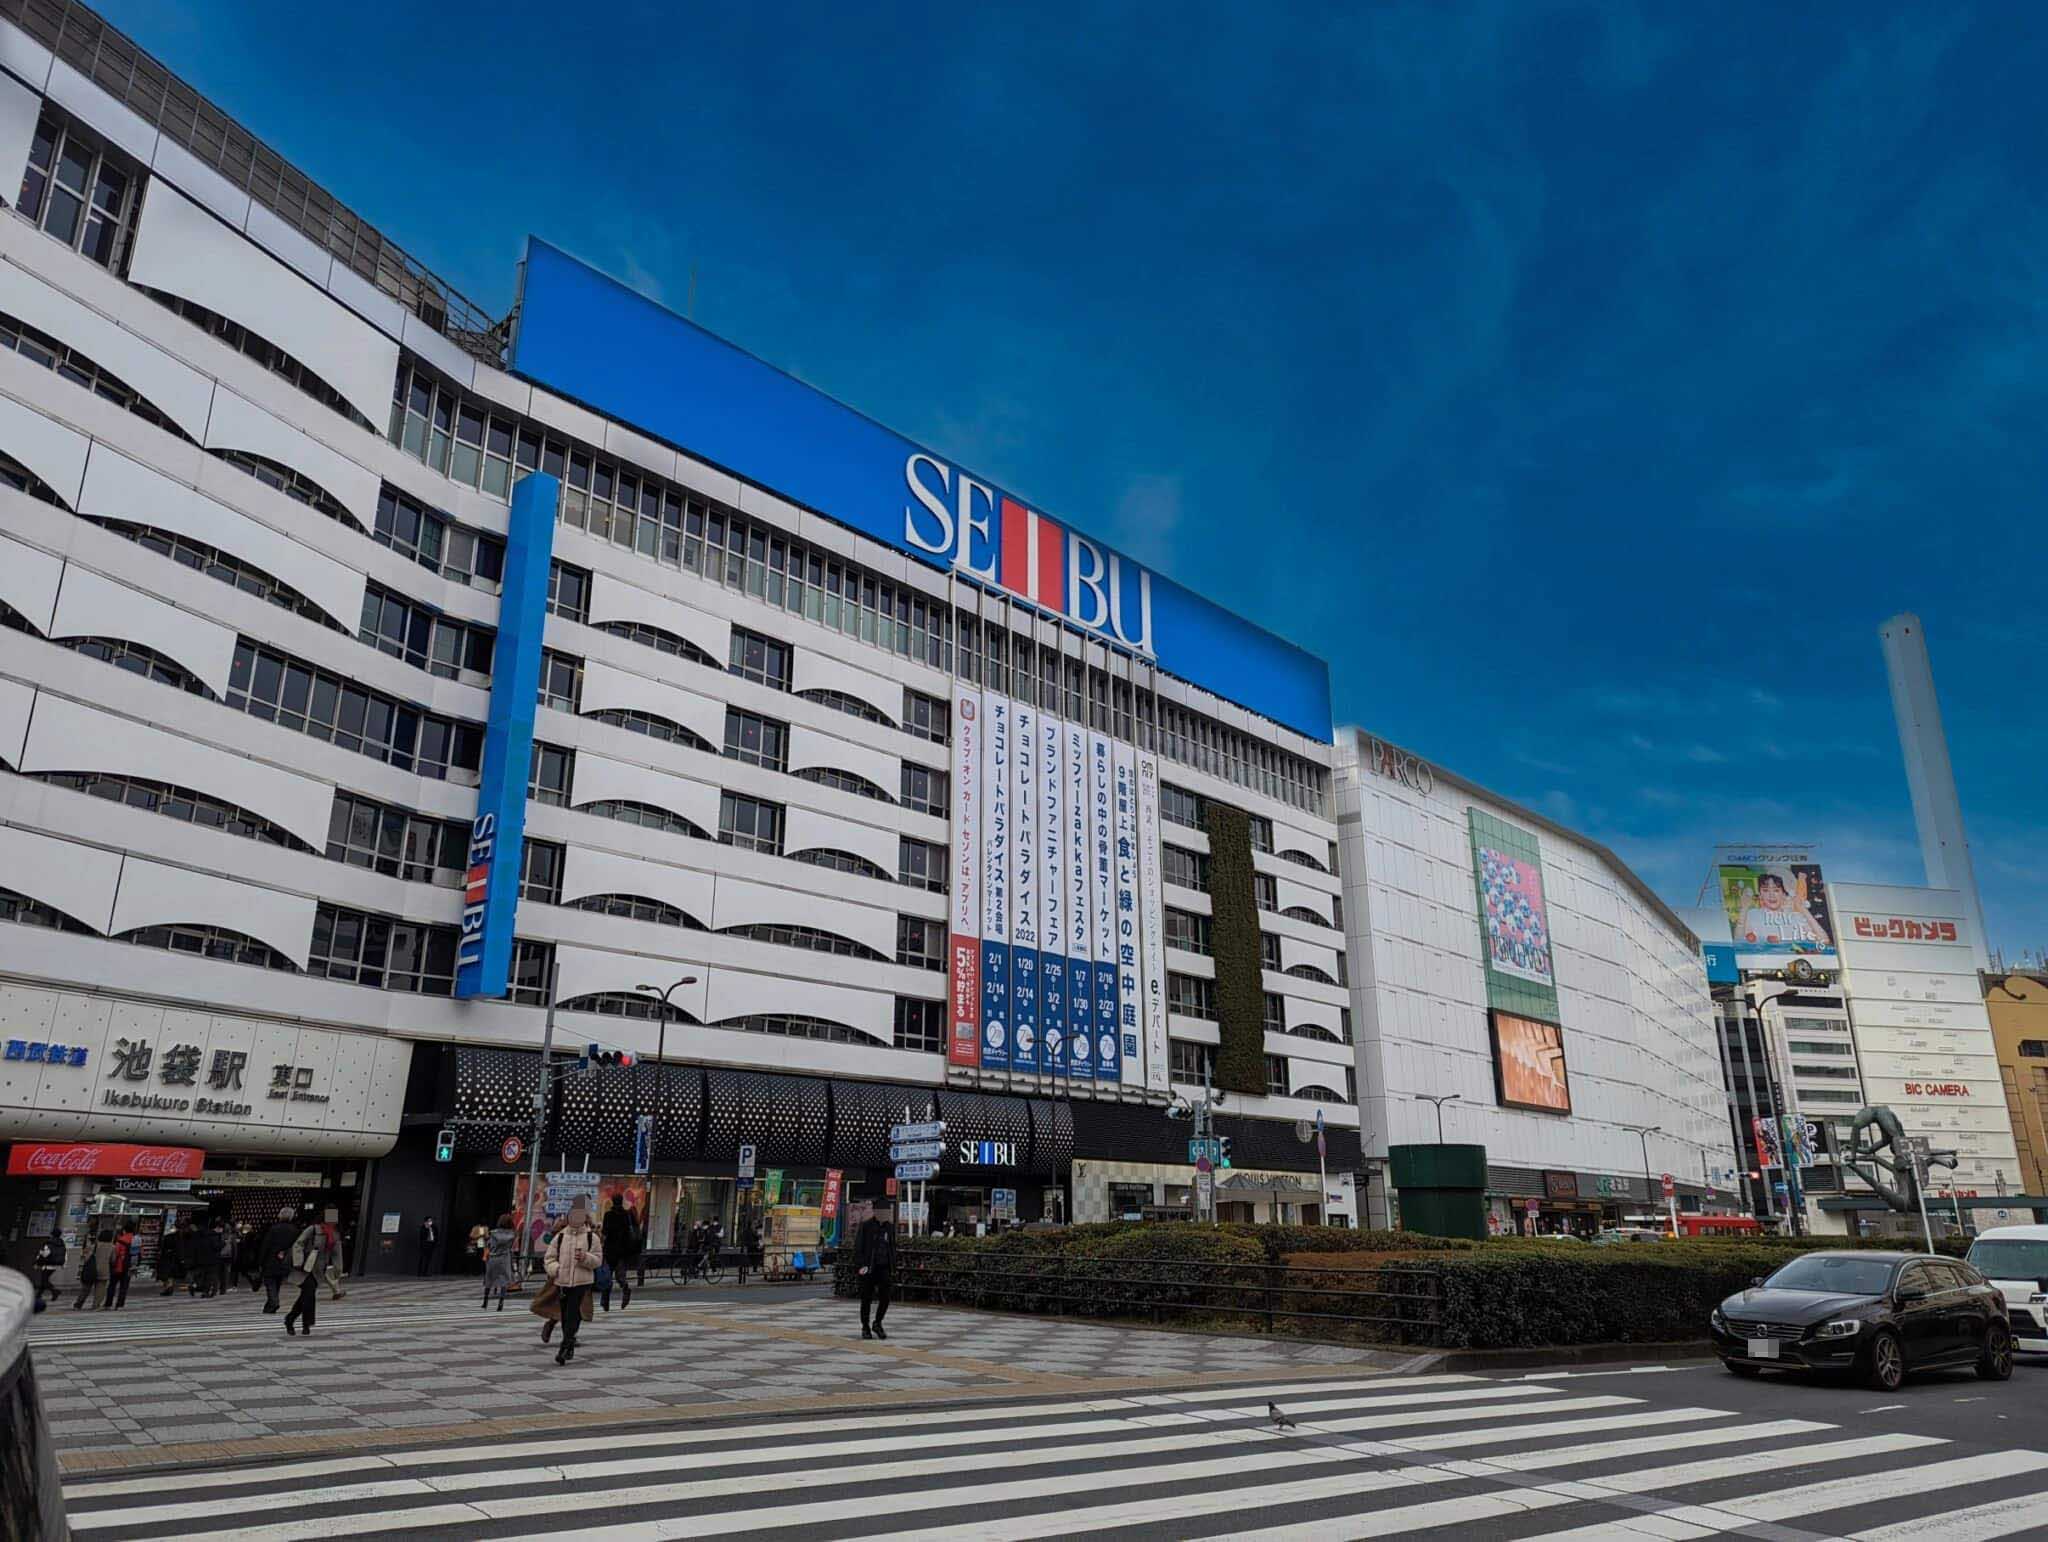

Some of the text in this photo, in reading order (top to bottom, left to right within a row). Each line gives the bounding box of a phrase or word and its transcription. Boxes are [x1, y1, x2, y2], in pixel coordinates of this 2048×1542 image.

[905, 453, 1158, 659] SEIBU
[1369, 737, 1434, 795] PARCO
[994, 705, 1005, 883] チョコレートパラダイス
[1020, 715, 1030, 926] チョコレートパラダイス
[1046, 727, 1058, 946] ブランドファニチャーフェア
[457, 812, 496, 968] SEIBU
[1015, 928, 1036, 942] 2022
[1854, 917, 1957, 942] ビックカメラ
[989, 953, 1002, 965] 2/1
[1017, 957, 1034, 971] 1/20
[1045, 963, 1062, 976] 2/25
[1075, 970, 1086, 982] 1/7
[987, 983, 1005, 996] 2/14
[1017, 987, 1034, 999] 2/14
[1048, 993, 1060, 1005] 3/2
[1073, 998, 1088, 1011] 1/30
[1099, 1000, 1115, 1013] 2/23
[4, 1039, 89, 1067] 西武鉄道
[107, 1037, 248, 1091] 池袋駅
[269, 1063, 314, 1089] 東口
[1904, 1082, 1970, 1097] BIC CAMERA
[103, 1089, 252, 1116] Ikebukuro Station
[27, 1148, 191, 1173] Coca-Cola Coca-Cola
[742, 1148, 752, 1165] P
[960, 1140, 1017, 1166] SEIBU
